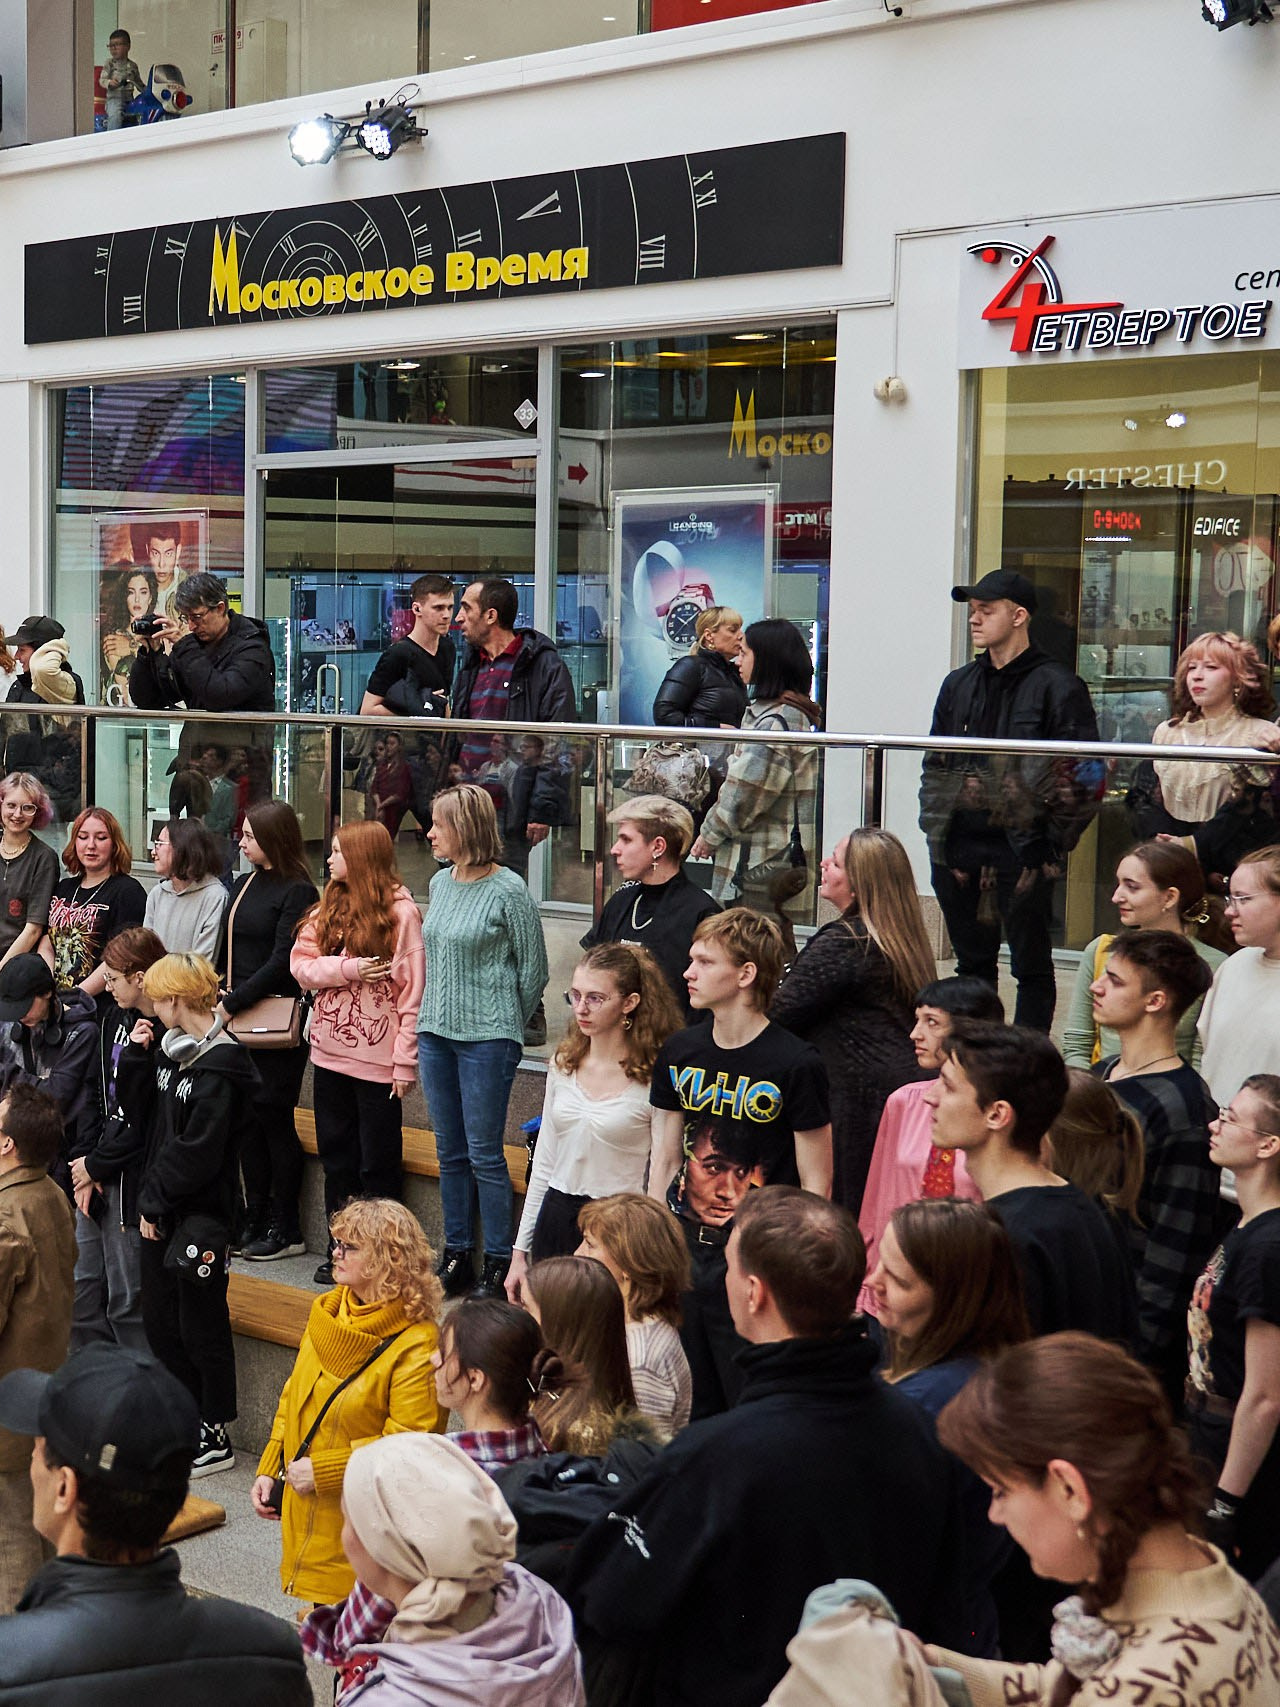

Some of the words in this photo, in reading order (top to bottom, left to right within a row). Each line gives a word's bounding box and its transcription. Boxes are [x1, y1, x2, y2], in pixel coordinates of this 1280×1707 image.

[209, 222, 434, 316] Московское
[445, 247, 589, 293] Время
[519, 408, 533, 420] 33
[1094, 509, 1141, 530] G-SHOCK
[1194, 517, 1241, 536] EDIFICE
